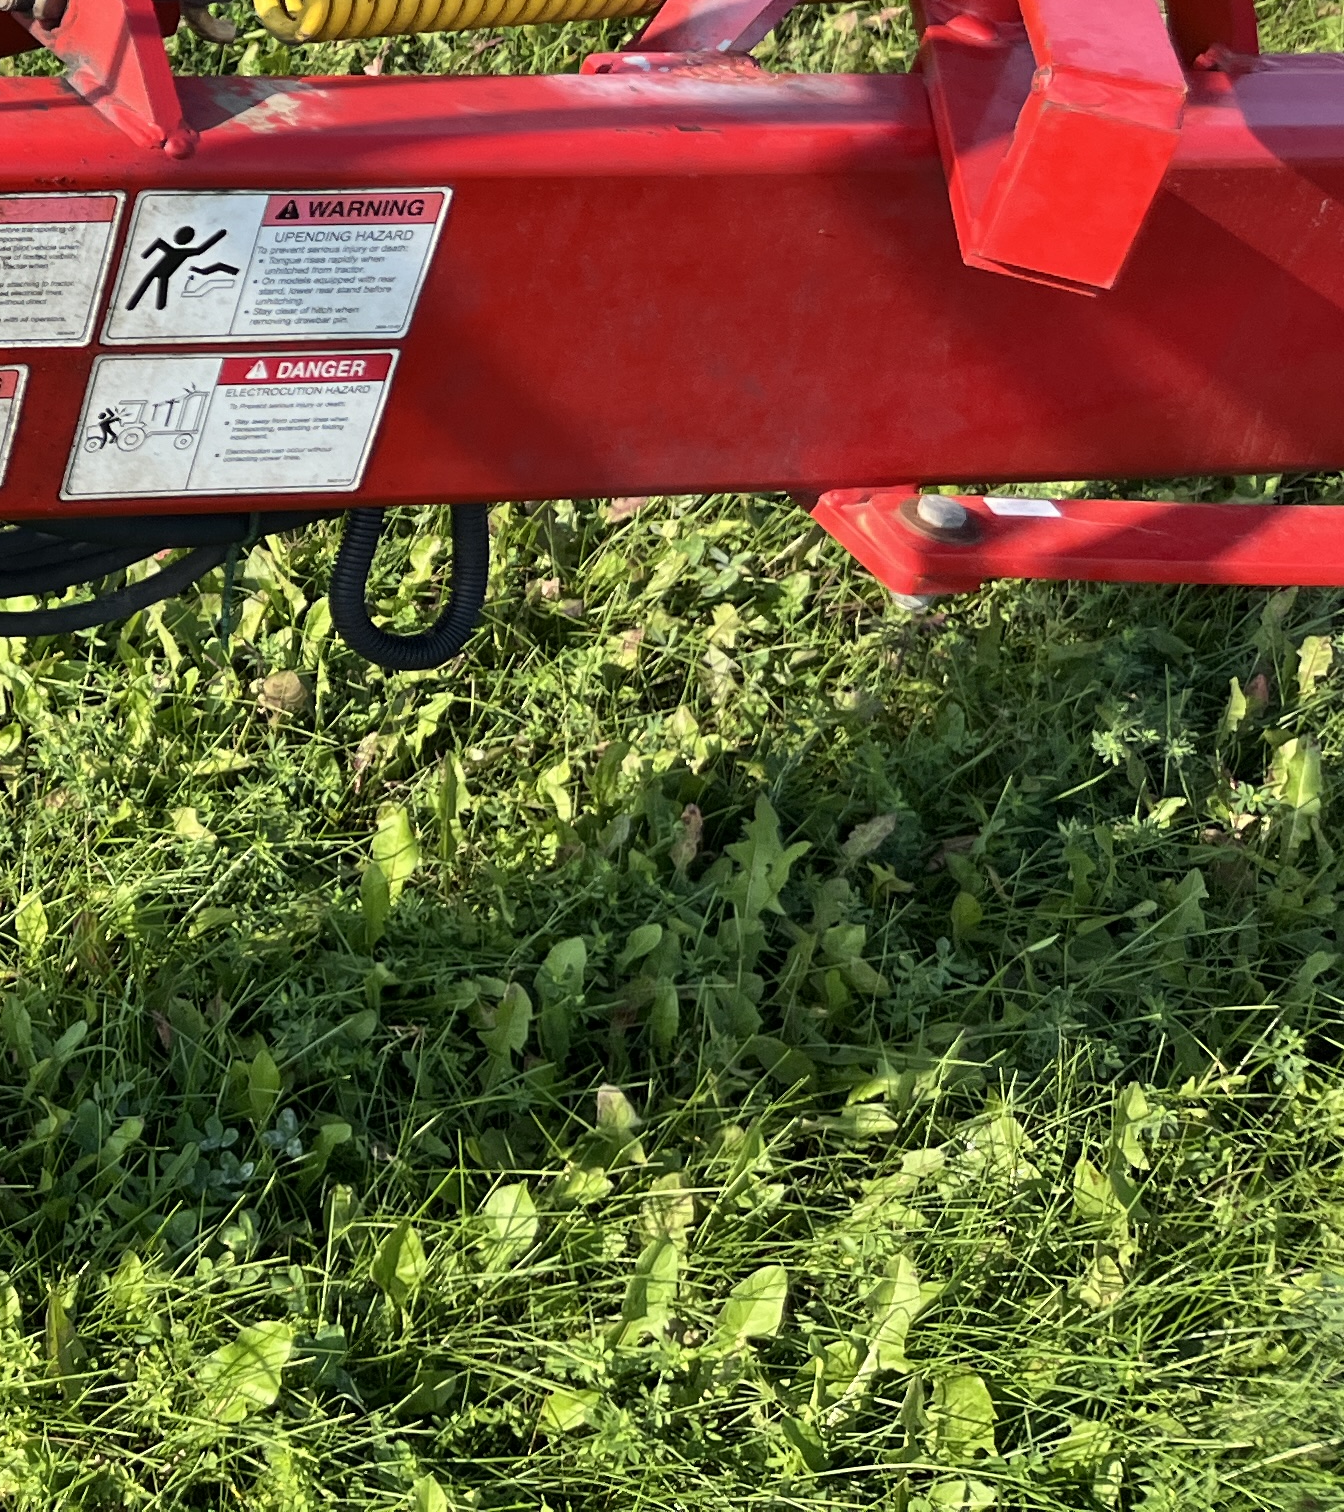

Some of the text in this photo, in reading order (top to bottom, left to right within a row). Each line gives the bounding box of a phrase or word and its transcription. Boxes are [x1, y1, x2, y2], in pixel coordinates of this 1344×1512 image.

[309, 199, 424, 218] WARNING
[275, 230, 413, 242] UPENDING HAZARD
[269, 246, 304, 255] prevent
[343, 246, 366, 254] injury
[328, 256, 358, 264] rapidly
[314, 277, 354, 285] equipped
[253, 308, 272, 316] Stay
[276, 360, 366, 379] DANGER
[226, 385, 371, 397] ELECTROCUTION HAZARD
